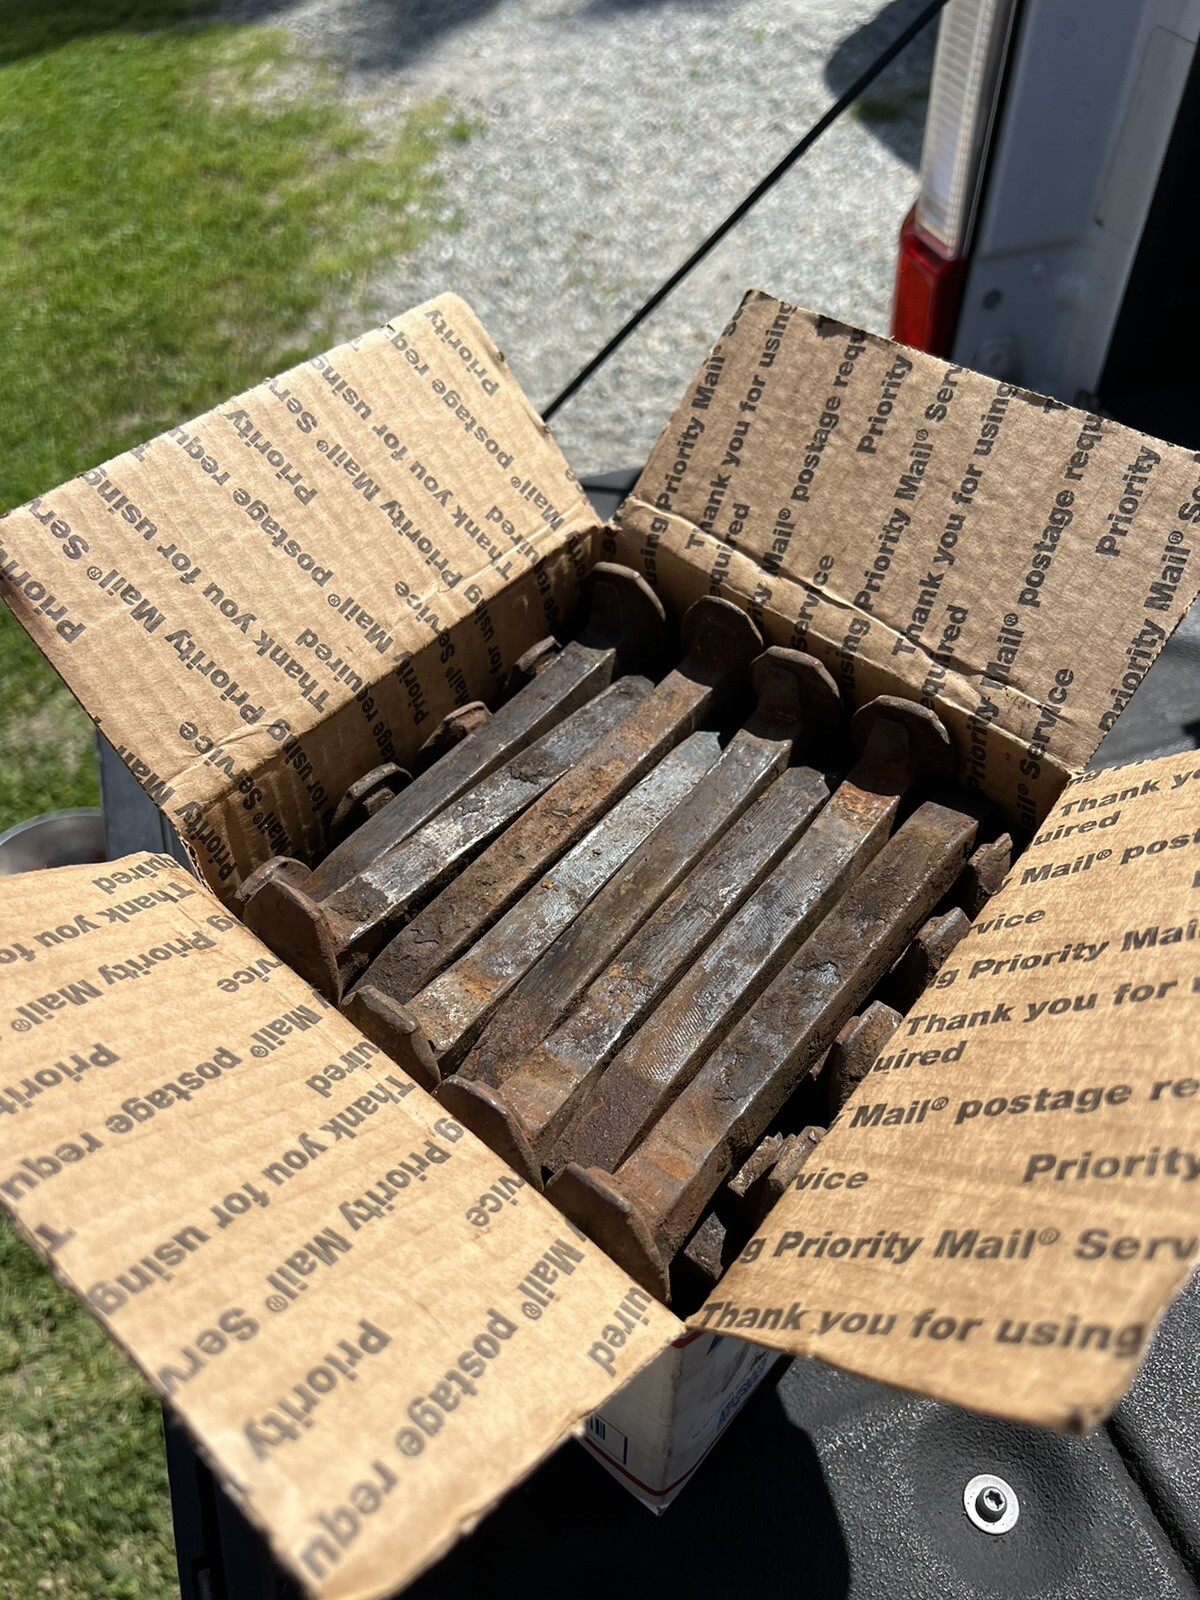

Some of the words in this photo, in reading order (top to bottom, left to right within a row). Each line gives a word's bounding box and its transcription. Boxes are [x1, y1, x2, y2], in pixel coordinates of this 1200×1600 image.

[310, 355, 373, 420] using
[425, 309, 500, 397] Priority
[372, 423, 408, 462] for
[432, 378, 515, 470] postage
[685, 472, 732, 550] Thank
[722, 420, 750, 467] you
[740, 375, 766, 412] for
[759, 302, 797, 369] using
[856, 354, 913, 454] Priority
[224, 408, 318, 506] Priority
[410, 461, 453, 507] you
[655, 417, 705, 511] Priority
[791, 396, 842, 503] postage
[82, 466, 158, 540] using
[233, 488, 334, 588] postage
[452, 505, 513, 581] Thank
[892, 571, 945, 656] Thank
[933, 514, 965, 566] you
[952, 464, 983, 505] for
[974, 383, 1017, 456] using
[1018, 490, 1075, 608] postage
[1064, 414, 1102, 481] requ
[1095, 445, 1161, 557] Priority
[157, 543, 202, 585] for
[381, 500, 463, 590] Priority
[708, 502, 750, 598] equired
[854, 508, 911, 612] Priority
[202, 582, 257, 634] you
[165, 629, 266, 724] Priority
[253, 630, 330, 713] Thank
[918, 604, 969, 711] equired
[1019, 668, 1074, 780] Service
[1061, 776, 1160, 818] Thank
[174, 801, 239, 881] Priority
[34, 913, 102, 948] you
[100, 881, 197, 923] Thank
[97, 930, 217, 986] Priority
[968, 940, 1110, 980] Priority
[1120, 919, 1200, 951] Mai
[906, 1003, 1014, 1036] Thank
[1023, 992, 1098, 1024] you
[1112, 980, 1178, 1006] for
[0, 1042, 122, 1117] Priorit
[105, 1046, 244, 1134] postage
[319, 1074, 417, 1139] Thank
[955, 1081, 1131, 1124] postage
[0, 1130, 104, 1201] requ
[261, 1133, 329, 1186] you
[338, 1138, 452, 1231] Priority
[209, 1182, 271, 1229] for
[773, 1231, 924, 1264] Priority
[86, 1224, 211, 1316] using
[698, 1302, 808, 1332] Thank
[812, 1308, 897, 1337] you
[909, 1307, 983, 1342] for
[996, 1316, 1147, 1359] using
[243, 1317, 393, 1461] Priority
[394, 1307, 519, 1457] postage
[300, 1458, 399, 1581] requ
